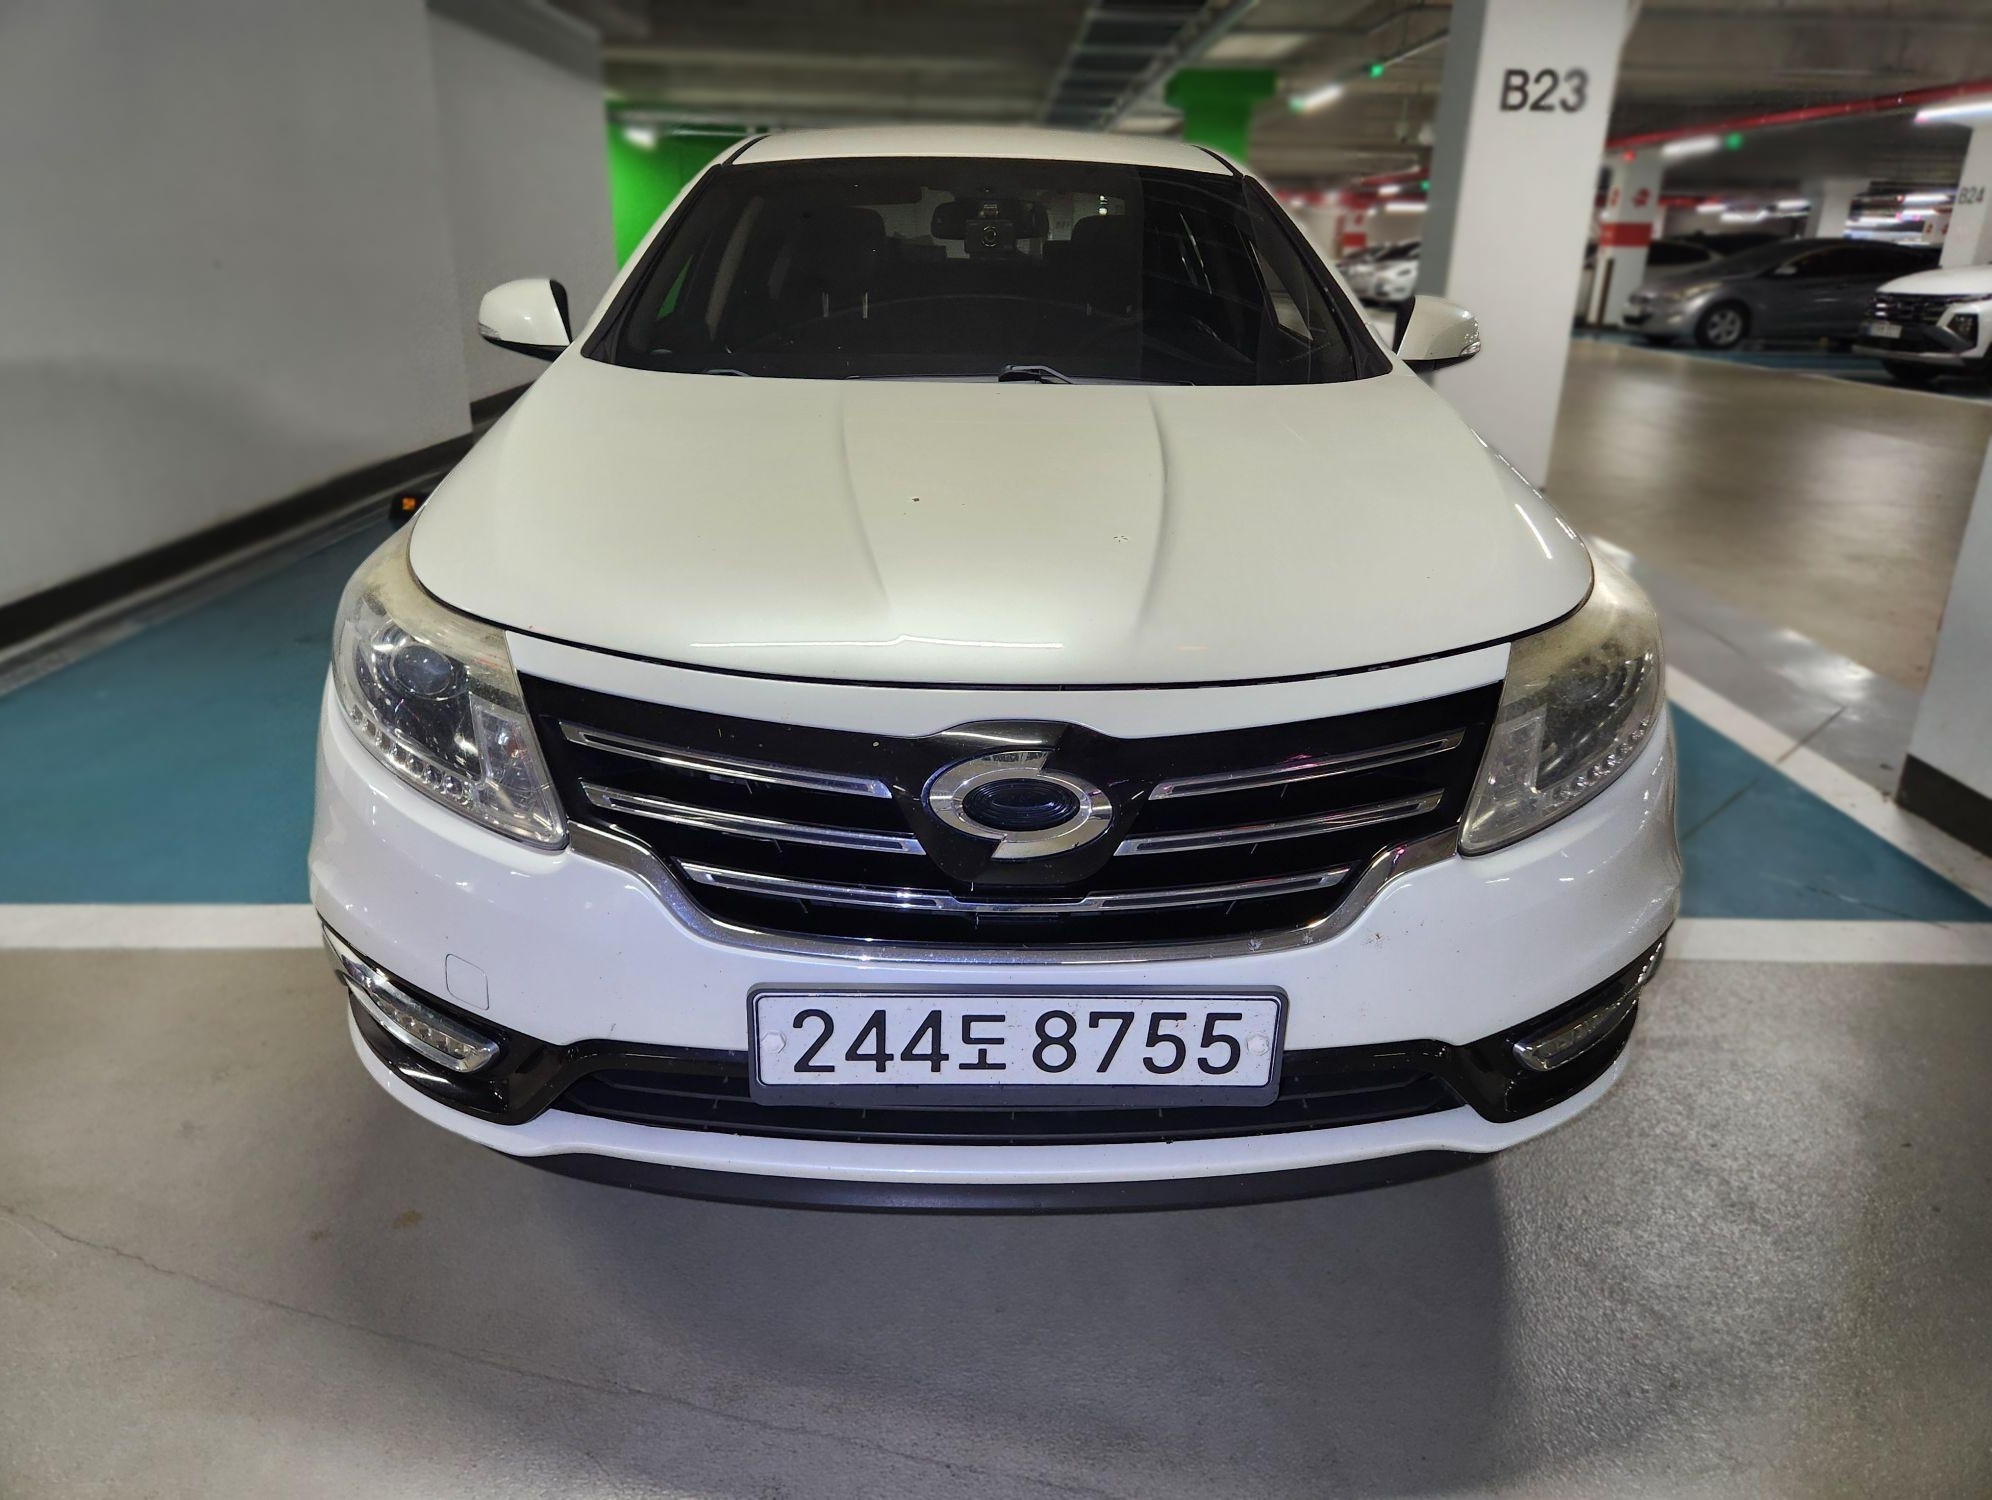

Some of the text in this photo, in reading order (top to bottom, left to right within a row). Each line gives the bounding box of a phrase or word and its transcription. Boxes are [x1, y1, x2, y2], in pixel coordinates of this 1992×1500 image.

[1500, 68, 1589, 113] B23
[793, 1008, 1243, 1075] 244도 8755
